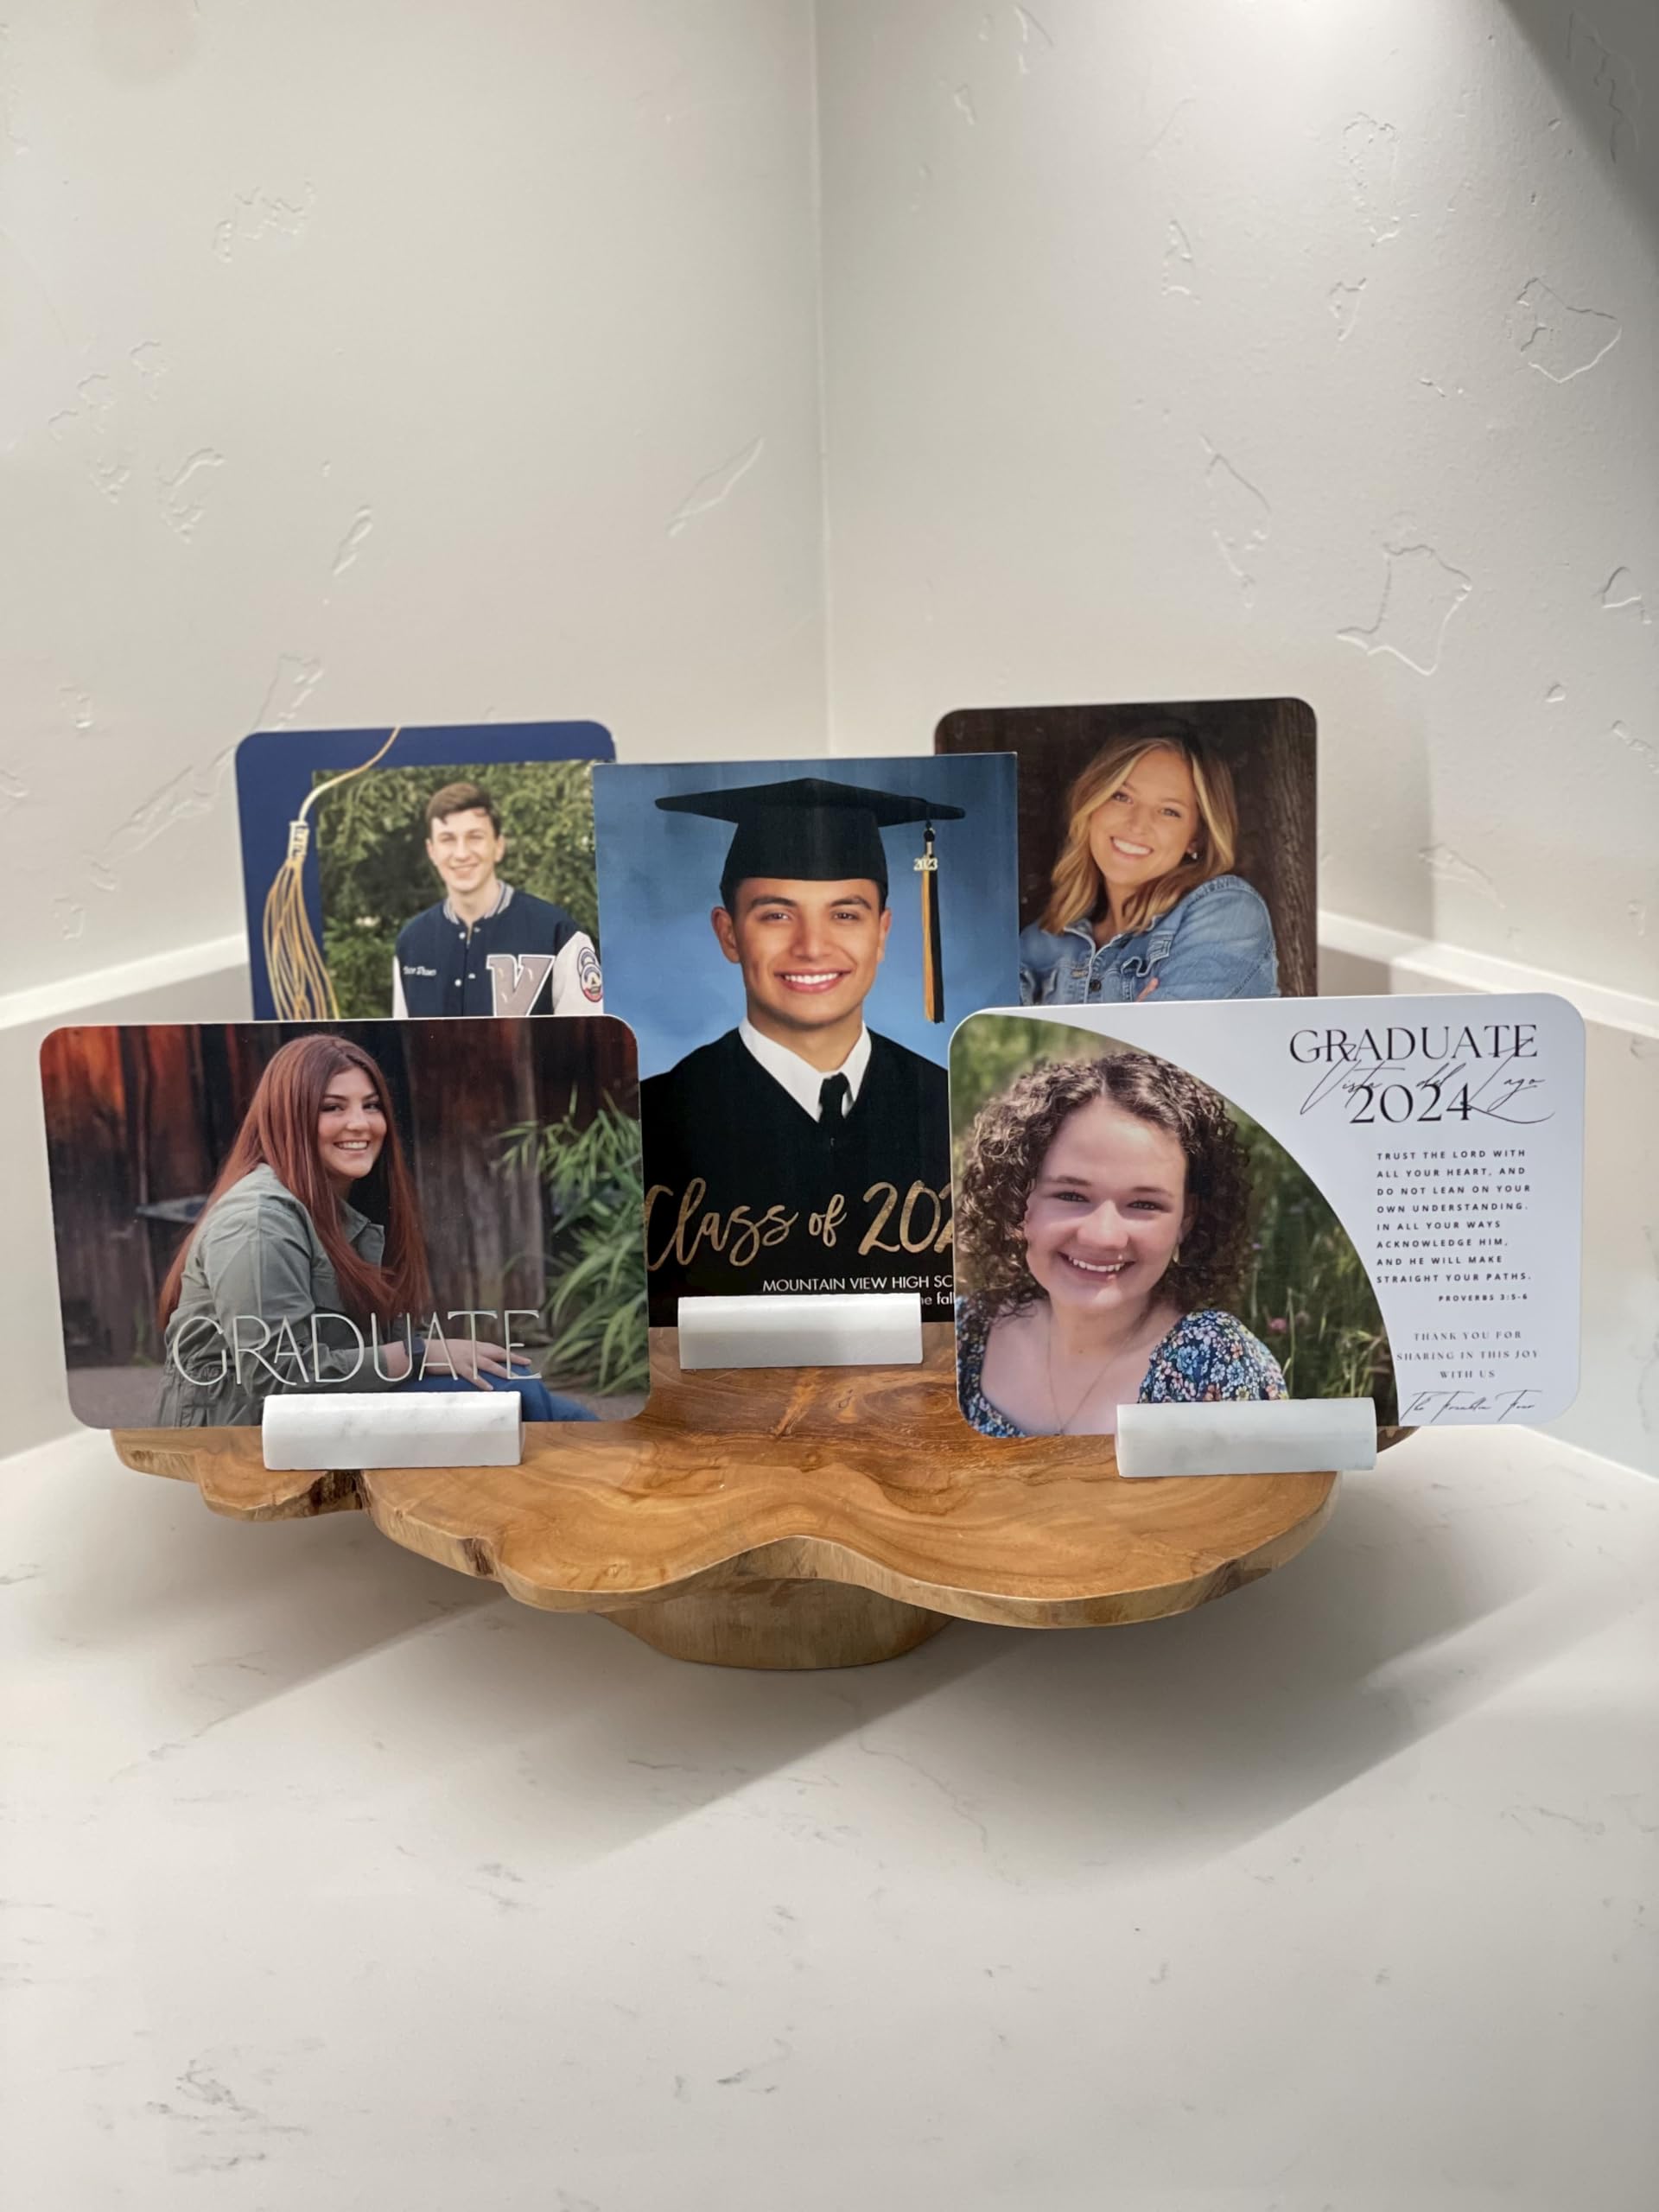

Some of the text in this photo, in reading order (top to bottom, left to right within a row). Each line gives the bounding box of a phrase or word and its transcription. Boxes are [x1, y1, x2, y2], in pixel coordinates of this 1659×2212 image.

[486, 954, 556, 1017] V
[1289, 1024, 1538, 1064] GRADUATE
[1350, 1083, 1472, 1123] 2024
[1377, 1149, 1526, 1160] TRUST THE LORD WITH
[1376, 1203, 1528, 1214] OWN UNDERSTANDING.
[644, 1177, 798, 1271] Class
[808, 1193, 847, 1247] of
[1466, 1220, 1501, 1229] WAYS
[1376, 1239, 1472, 1249] ACKNOWLEDGE
[1376, 1274, 1439, 1283] STRAIGHT
[1486, 1272, 1531, 1281] PATHS.
[762, 1277, 845, 1292] MOUNTAIN
[850, 1277, 887, 1290] VIEW
[892, 1275, 929, 1289] HIGH
[1414, 1332, 1457, 1341] THANK
[173, 1309, 542, 1386] GRADUATE
[1396, 1351, 1454, 1361] SHARING
[1460, 1351, 1473, 1359] IN
[1515, 1350, 1538, 1358] JOY
[1440, 1370, 1496, 1379] WITH US
